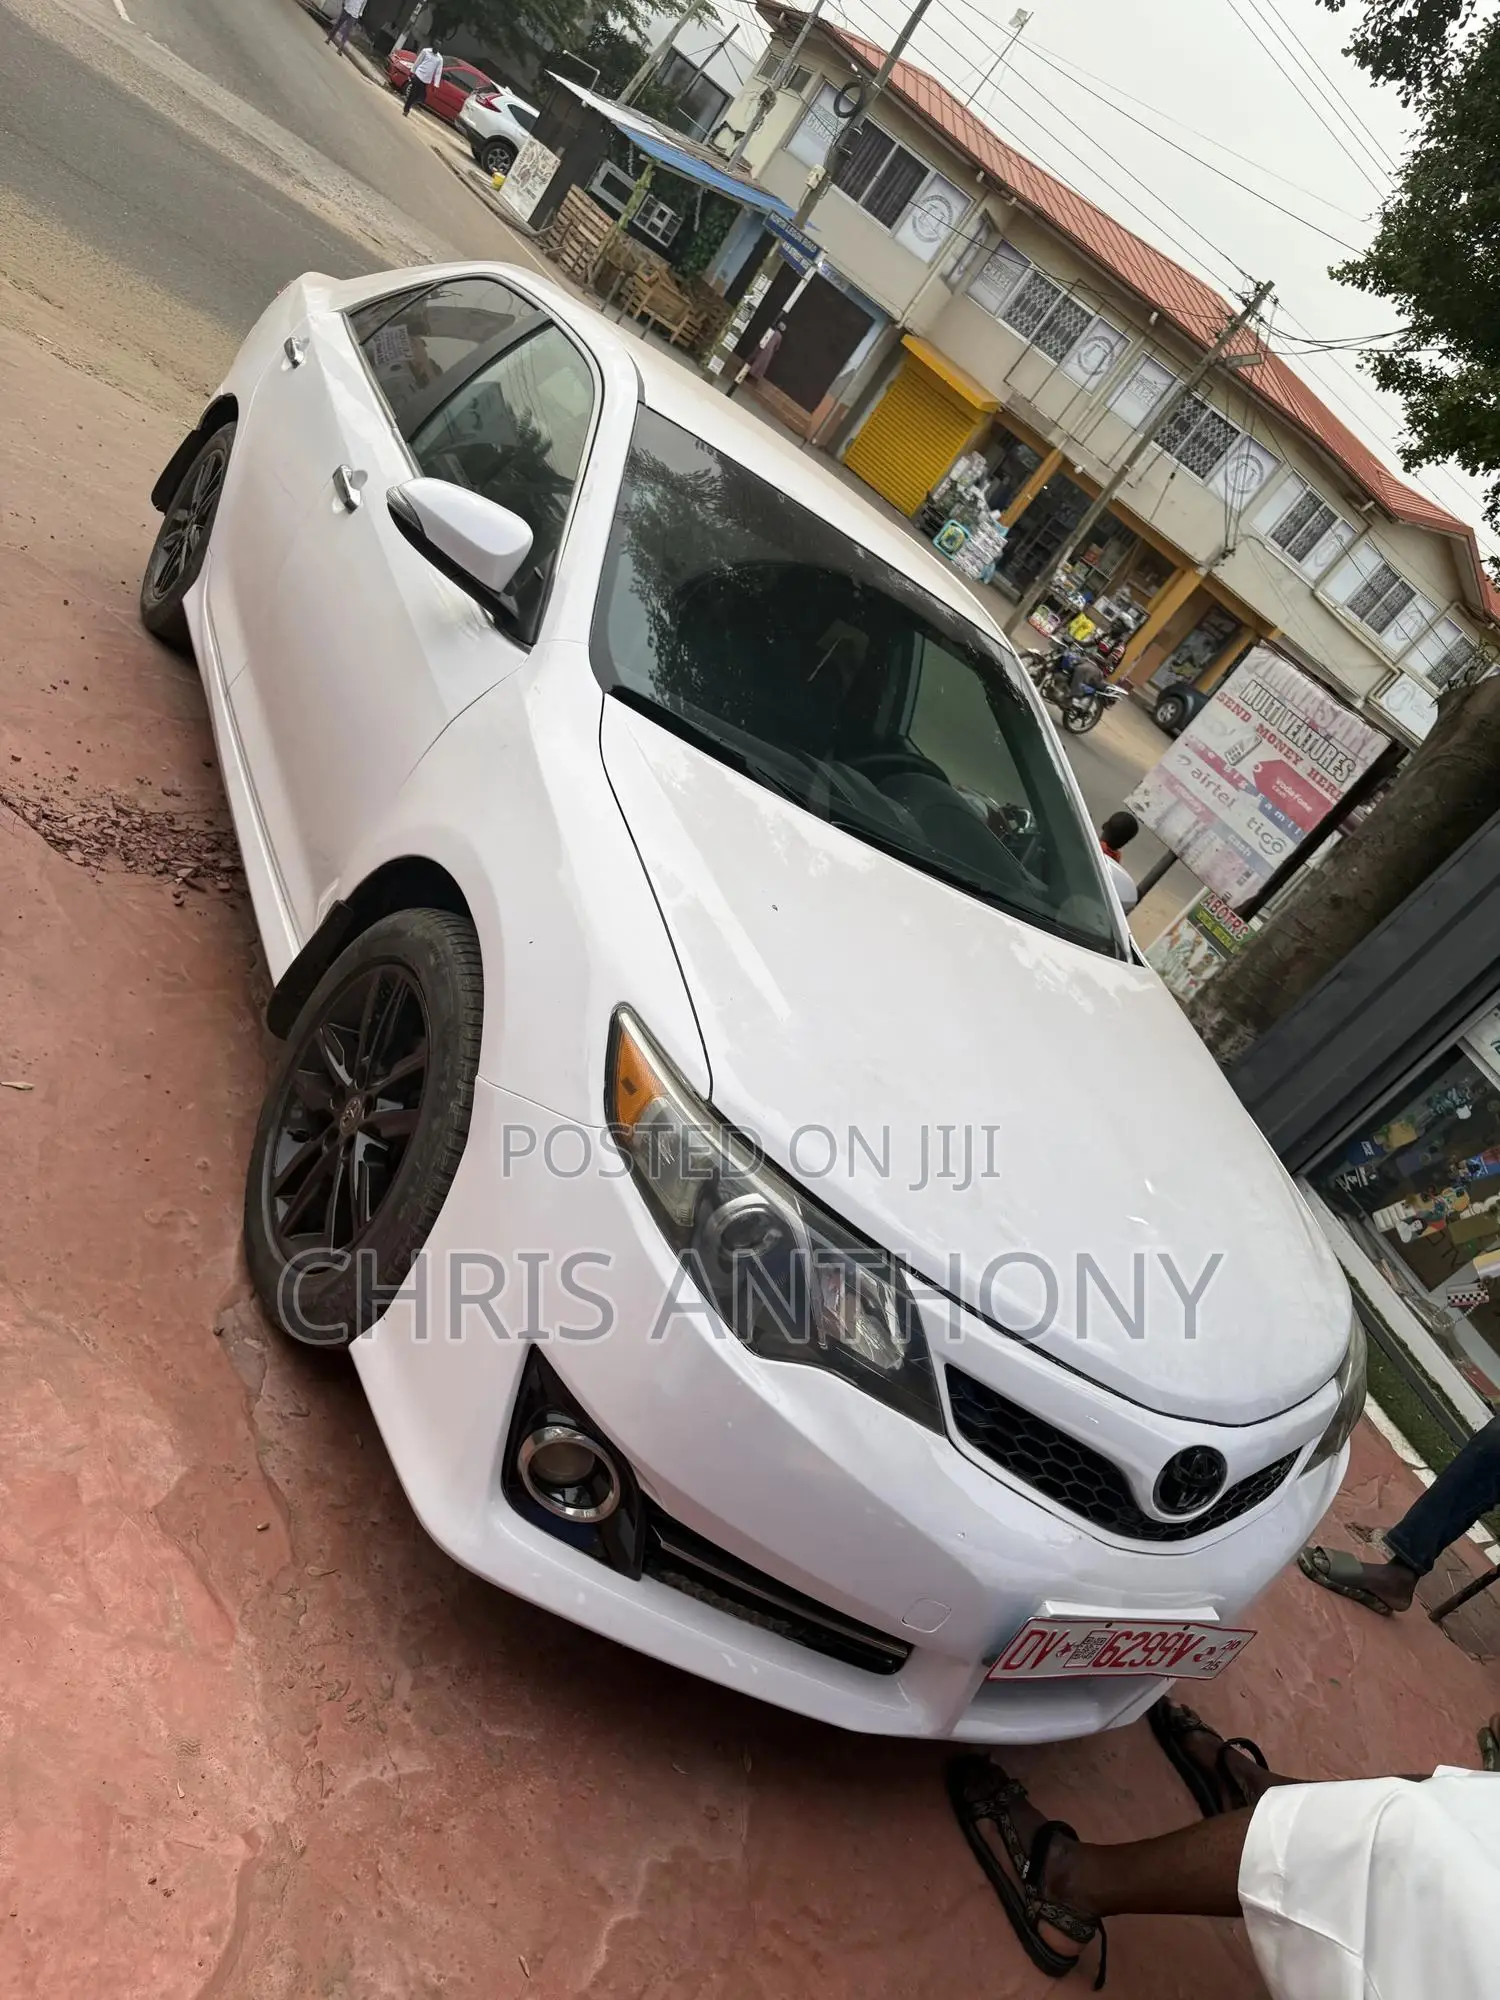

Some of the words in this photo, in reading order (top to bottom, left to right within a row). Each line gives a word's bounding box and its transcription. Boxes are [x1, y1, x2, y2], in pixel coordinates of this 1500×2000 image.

[1215, 690, 1252, 724] SEND
[1254, 722, 1304, 767] MONEY
[1188, 764, 1238, 811] airtel
[1002, 1629, 1070, 1670] DV
